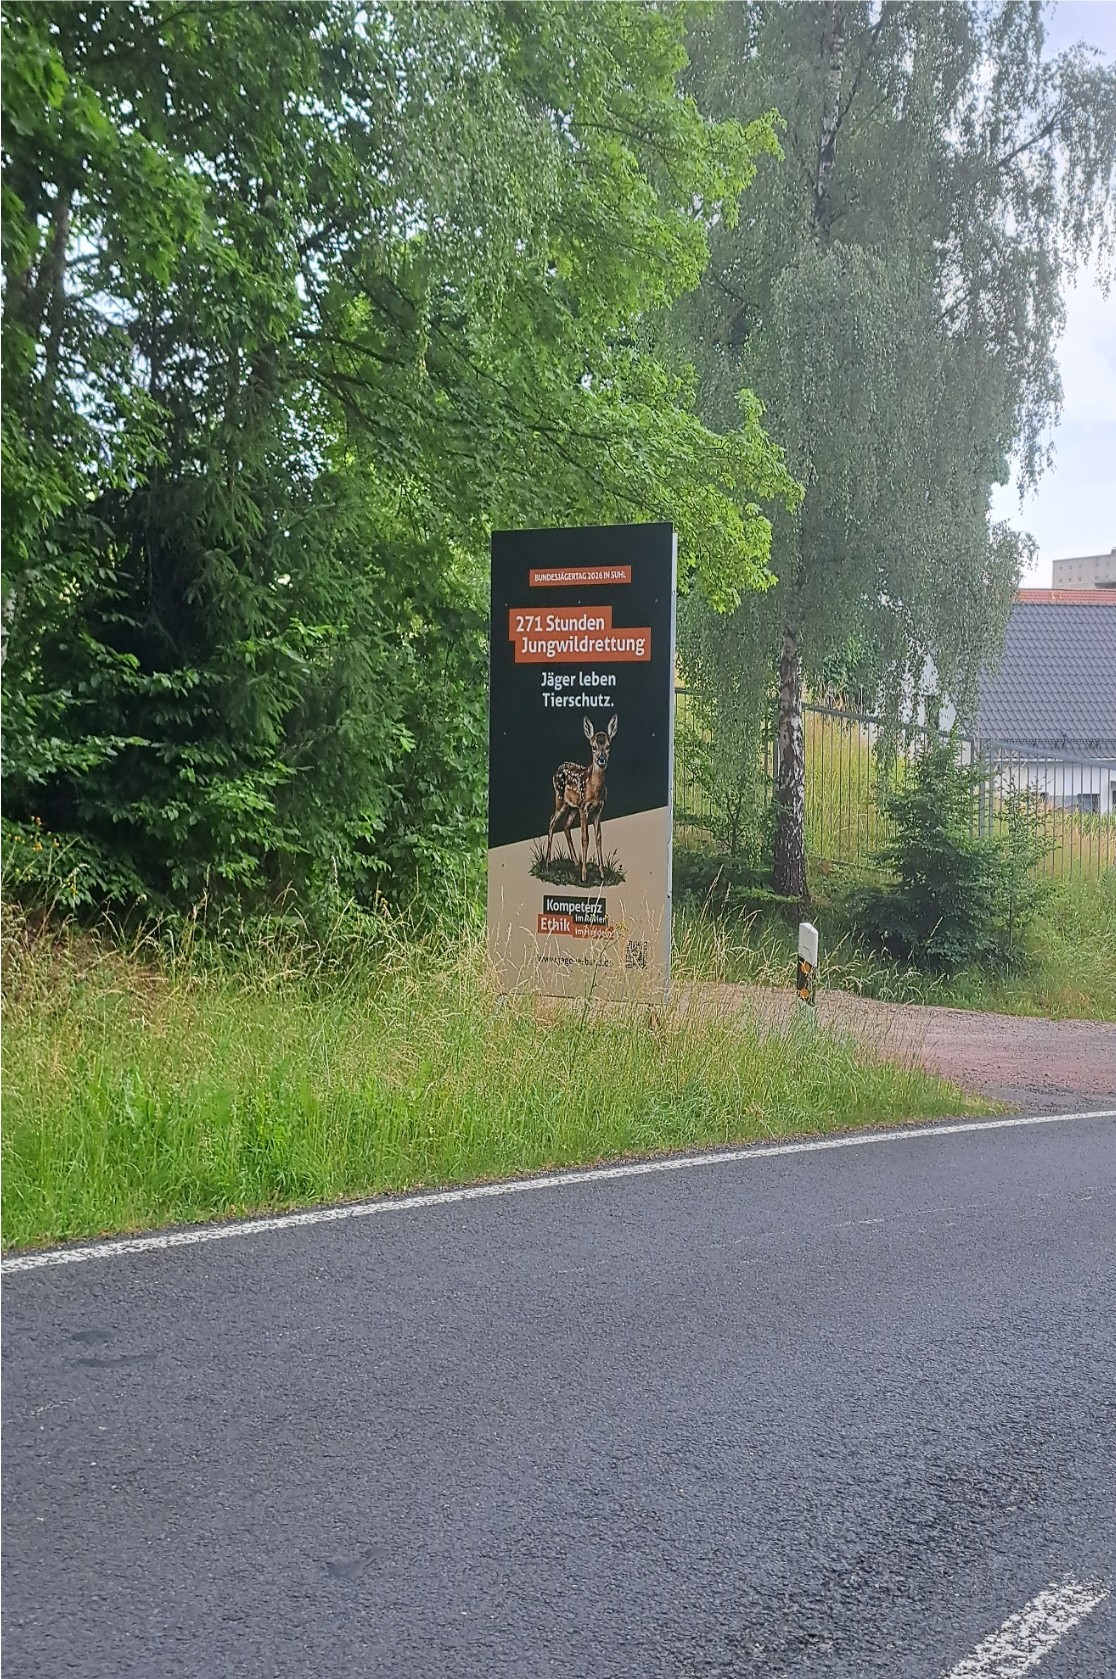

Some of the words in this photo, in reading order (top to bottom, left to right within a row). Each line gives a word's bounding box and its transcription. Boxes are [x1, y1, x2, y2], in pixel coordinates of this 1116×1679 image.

[534, 572, 587, 582] BUNDESJÄGERTAG
[587, 572, 603, 580] 2026
[603, 571, 610, 579] IN
[610, 571, 626, 579] SUHL
[516, 616, 542, 631] 271
[546, 614, 604, 631] Stunden
[522, 636, 645, 657] Jungwildrettung
[540, 671, 576, 690] Jäger
[579, 671, 616, 686] leben
[542, 692, 615, 708] Tierschutz.
[547, 899, 602, 914] Kompetenz
[541, 918, 570, 931] Ethik
